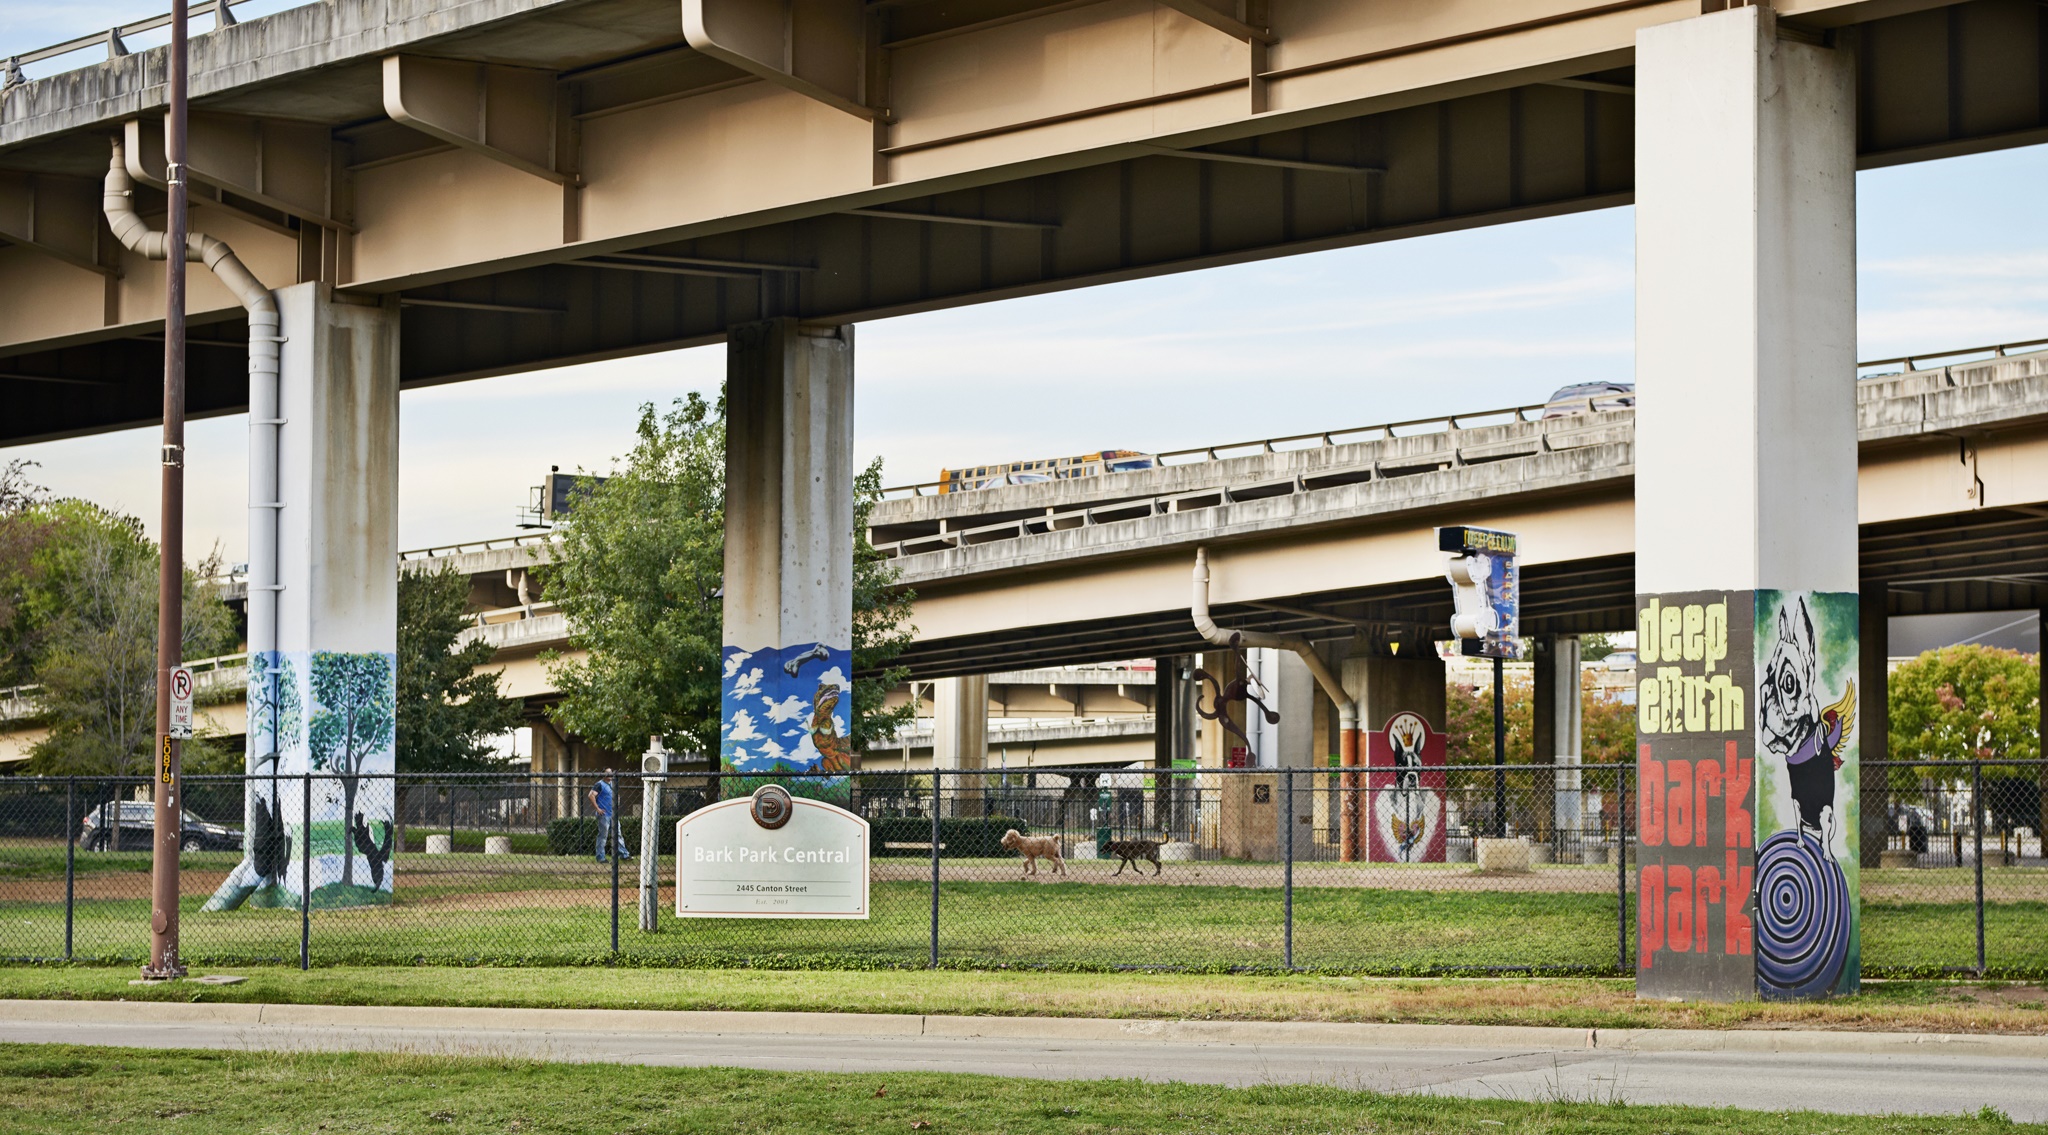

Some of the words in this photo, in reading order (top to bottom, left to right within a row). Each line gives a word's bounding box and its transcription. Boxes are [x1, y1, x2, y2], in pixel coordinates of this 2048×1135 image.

[1502, 561, 1513, 599] BARK
[1639, 595, 1727, 675] deep
[175, 715, 188, 723] TIME
[1639, 668, 1744, 733] ellum
[163, 736, 171, 782] E0878
[1640, 740, 1754, 848] bark
[694, 846, 733, 862] Bark
[739, 846, 778, 862] Park
[783, 846, 850, 863] Central
[785, 885, 807, 893] Street
[1640, 850, 1755, 969] park
